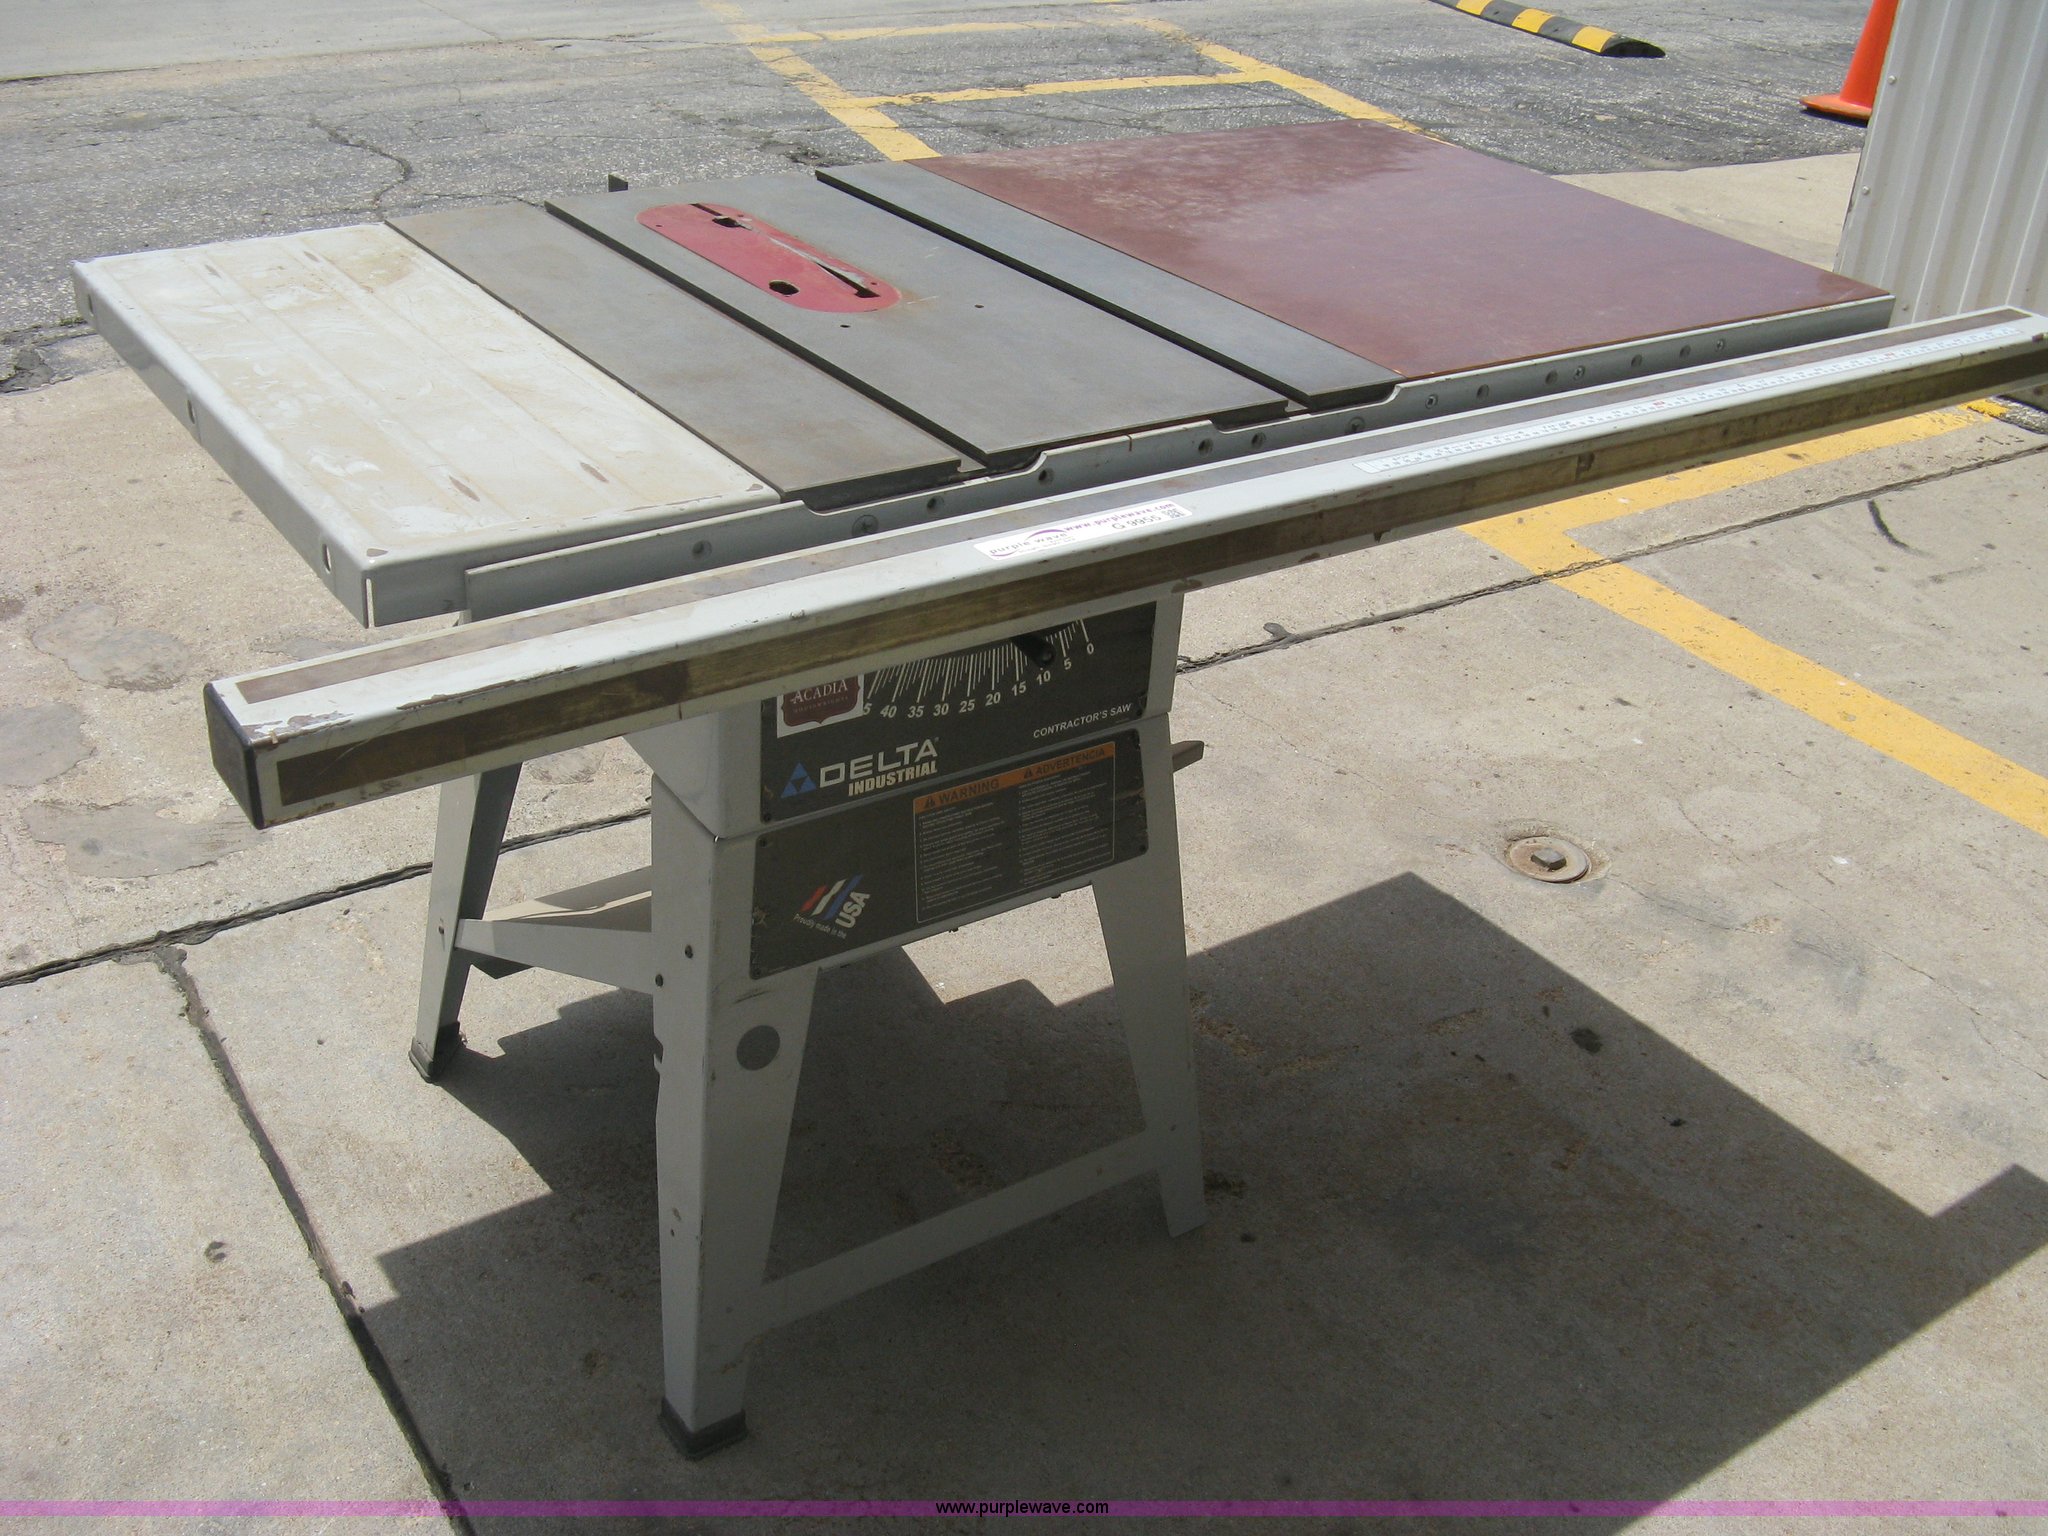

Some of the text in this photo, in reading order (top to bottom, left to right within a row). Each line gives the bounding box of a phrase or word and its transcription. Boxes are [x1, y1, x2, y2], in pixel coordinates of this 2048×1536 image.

[1065, 502, 1175, 532] www.purplewave.com
[1111, 514, 1162, 530] G 9955
[989, 539, 1030, 554] purple
[1034, 531, 1067, 546] wave
[789, 679, 848, 704] ACADIA
[880, 705, 897, 719] 40
[907, 705, 924, 718] 35
[933, 703, 949, 717] 30
[958, 699, 976, 713] 25
[985, 692, 1001, 706] 20
[1011, 681, 1027, 695] 15
[1036, 670, 1051, 685] 10
[1063, 658, 1072, 671] 5
[1086, 642, 1095, 655] 0
[1033, 703, 1132, 739] CONTRACTOR'S SAW
[820, 739, 938, 788] DELTA
[1035, 748, 1105, 777] ADVERTENCIA
[848, 760, 938, 796] INDUSTRIAL
[939, 779, 1000, 803] WARNING
[835, 891, 870, 928] USA
